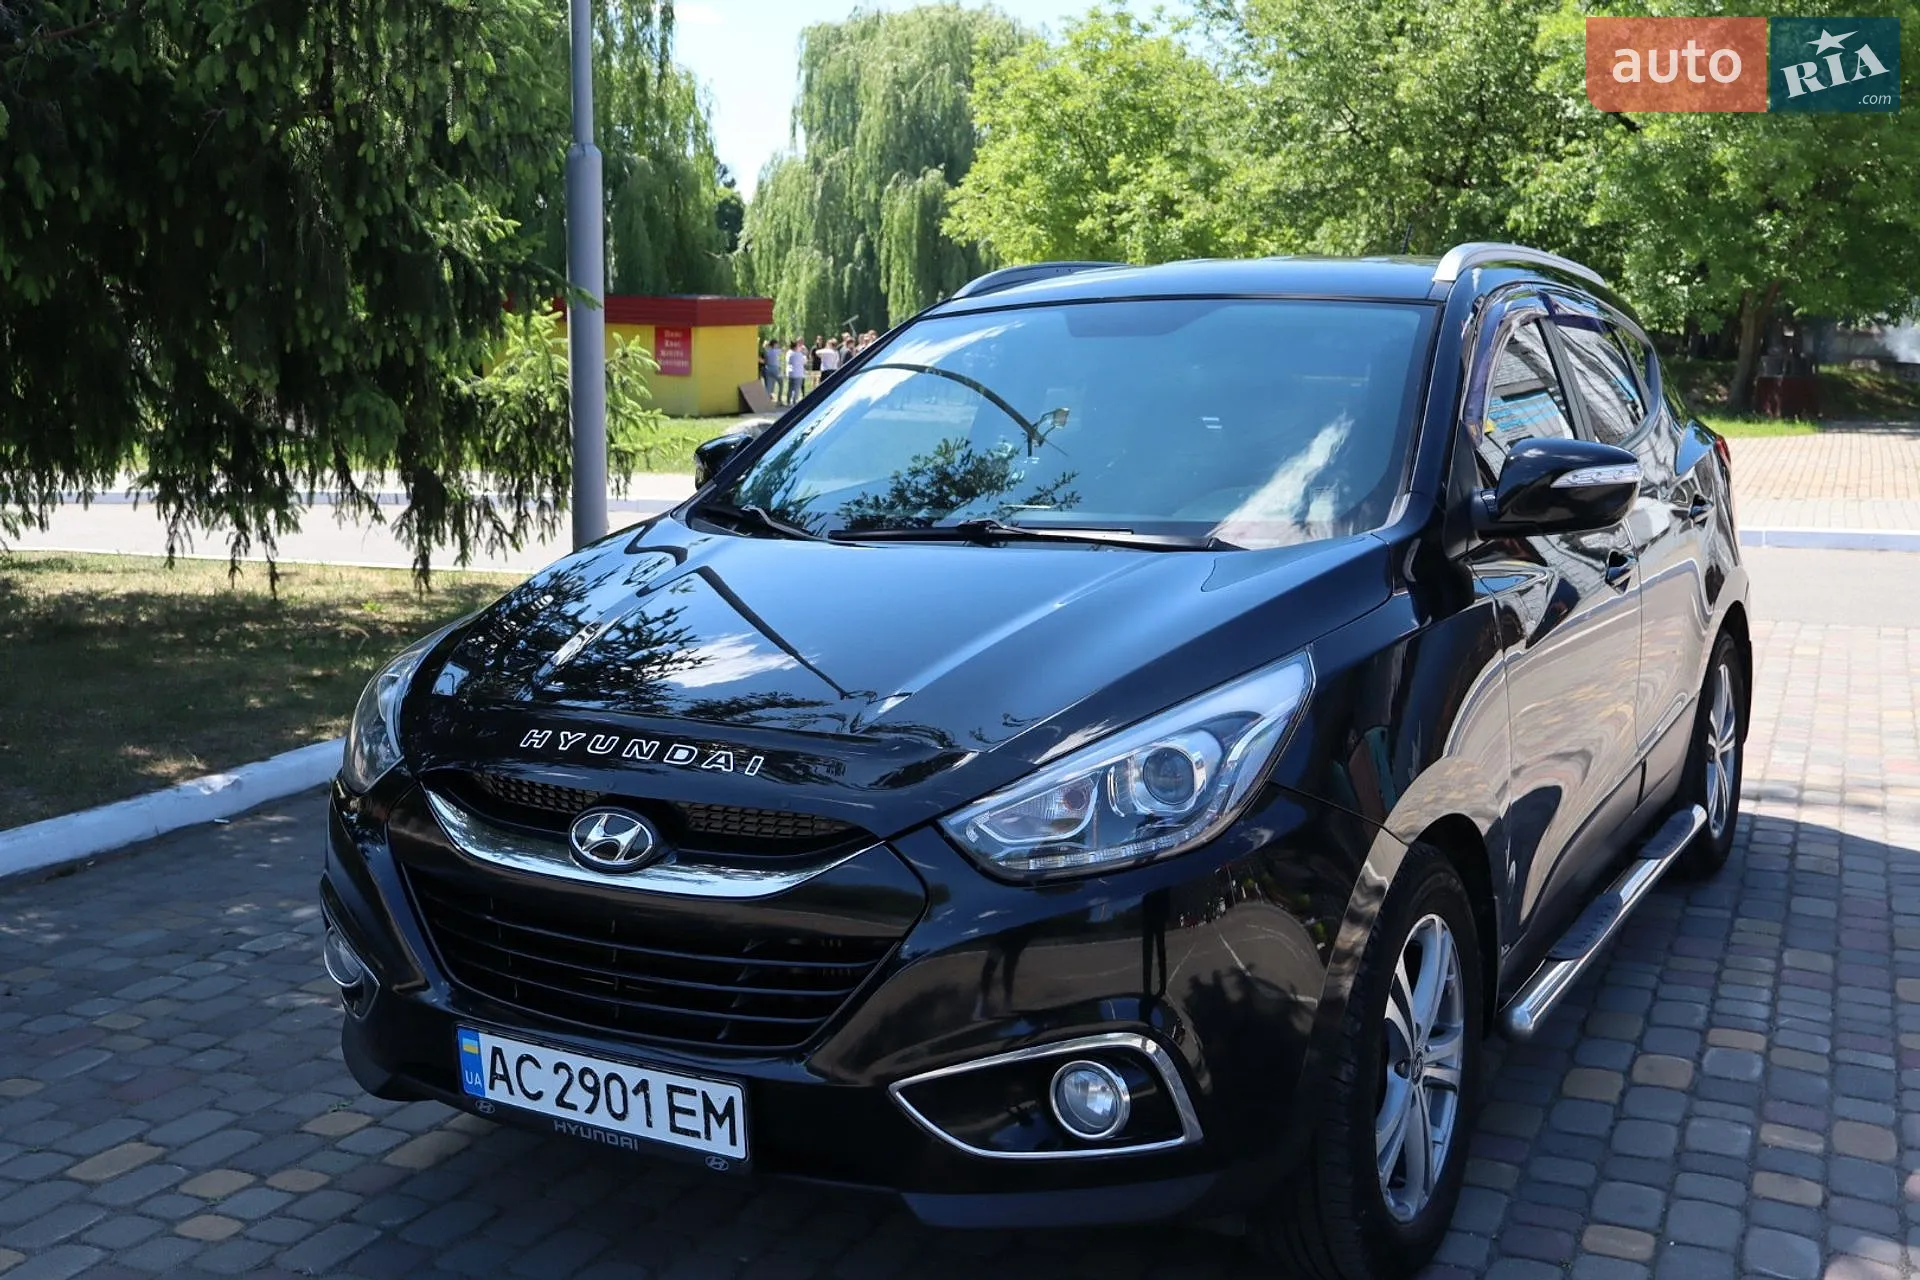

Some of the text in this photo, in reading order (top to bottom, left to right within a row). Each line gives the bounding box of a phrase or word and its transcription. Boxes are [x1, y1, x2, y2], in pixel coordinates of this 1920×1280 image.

[520, 729, 764, 776] HYUNDAI
[464, 1073, 483, 1087] UA
[488, 1046, 738, 1146] AC 2901 EM
[553, 1119, 639, 1151] HYUNDAI
